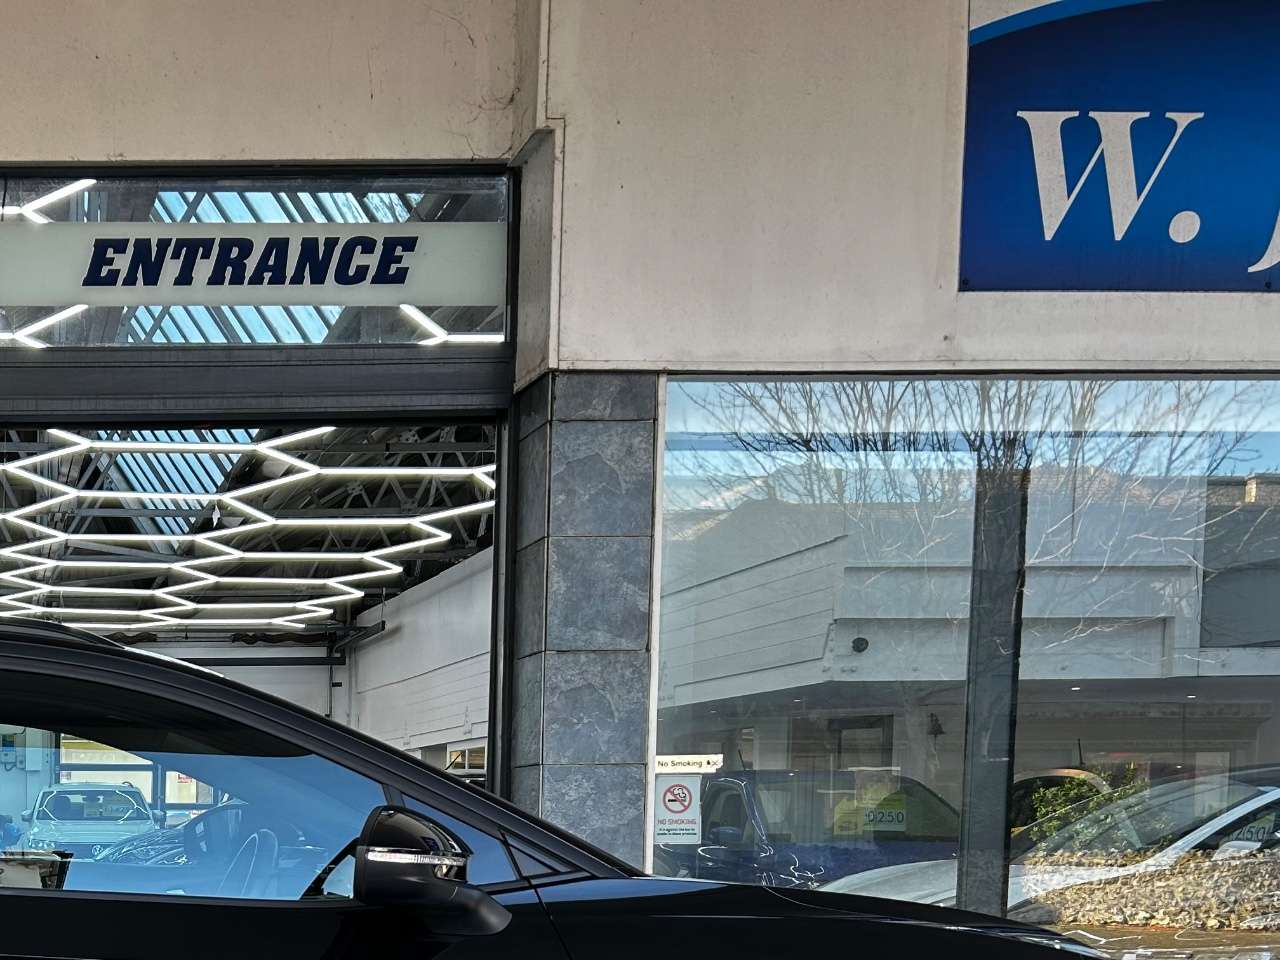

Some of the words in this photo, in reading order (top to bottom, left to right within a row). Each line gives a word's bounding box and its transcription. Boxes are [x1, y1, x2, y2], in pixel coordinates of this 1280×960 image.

[1016, 110, 1203, 243] W.
[81, 236, 419, 287] ENTRANCE
[670, 760, 703, 768] Smoking
